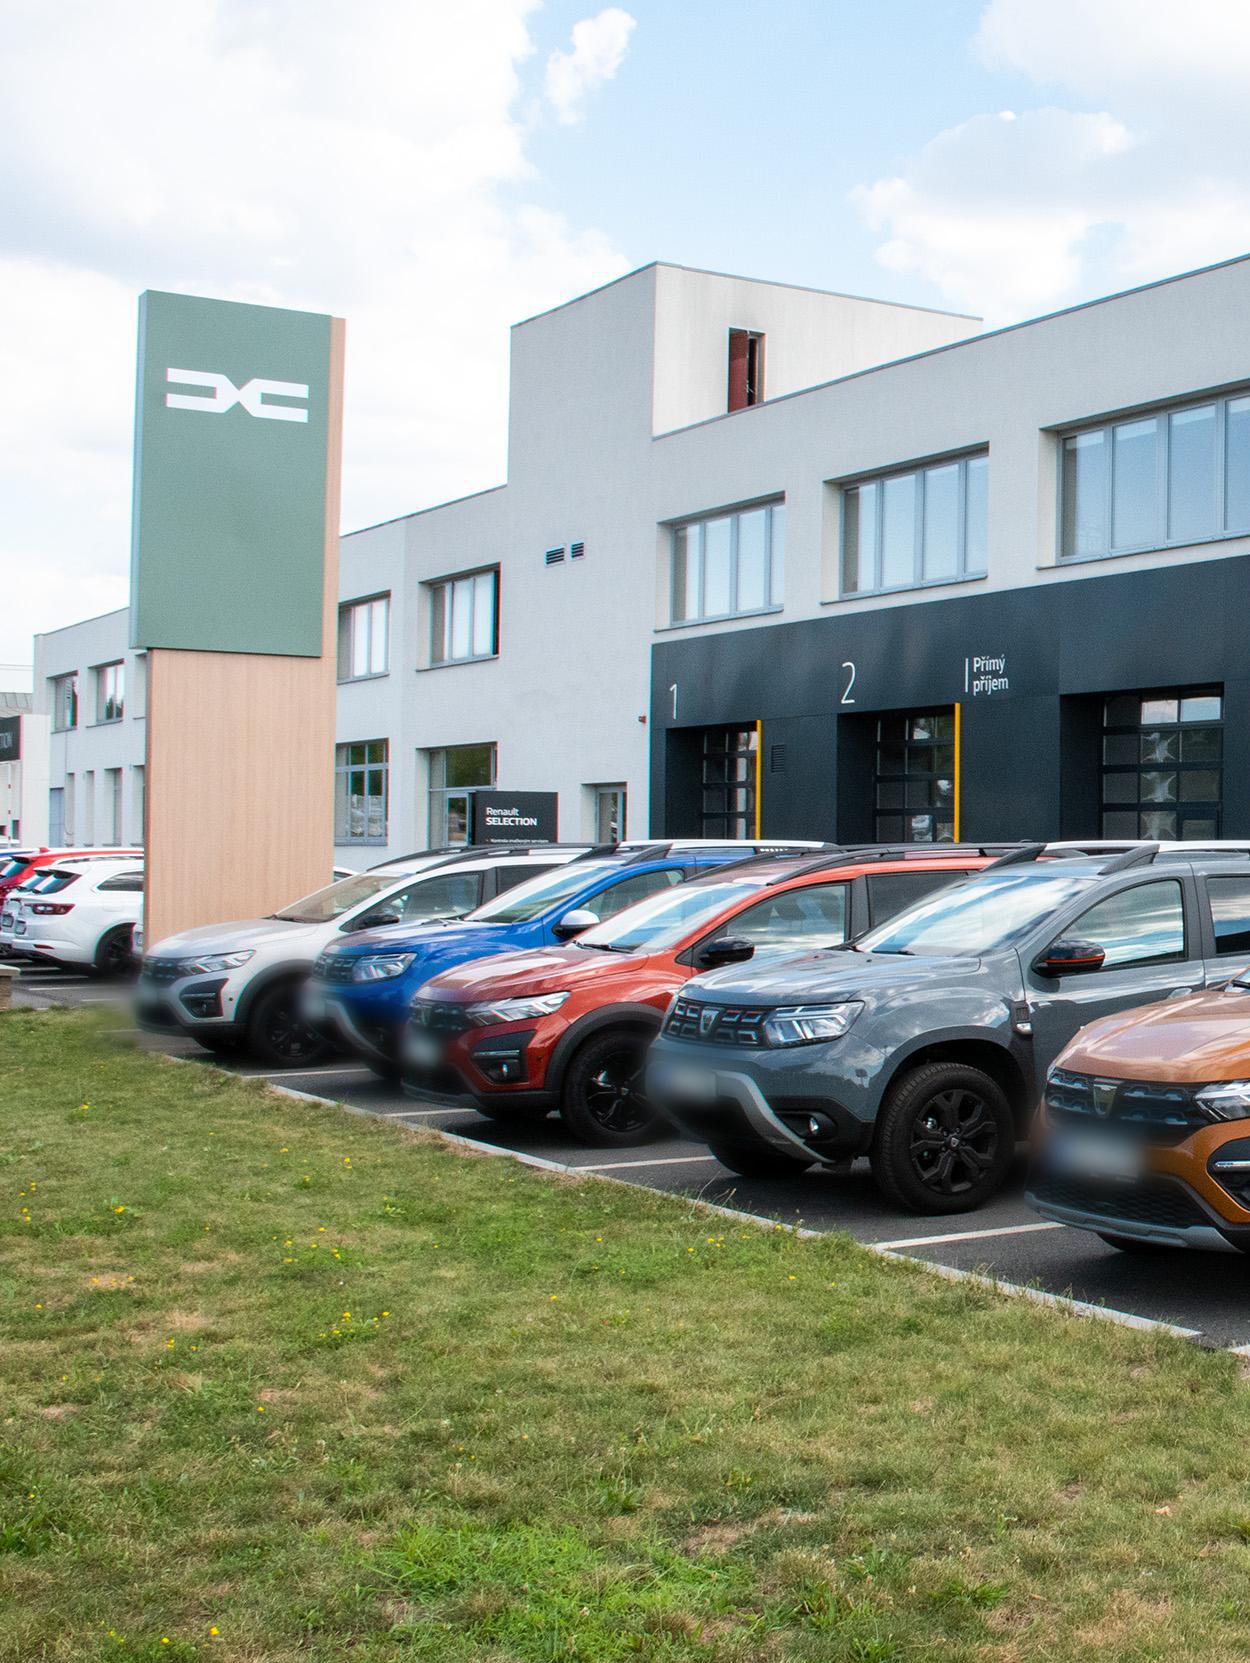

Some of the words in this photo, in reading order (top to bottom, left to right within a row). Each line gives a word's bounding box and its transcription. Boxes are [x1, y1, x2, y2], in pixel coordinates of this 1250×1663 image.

[973, 653, 1006, 674] Přímý
[840, 661, 856, 704] 2
[973, 675, 1009, 696] příjem
[669, 683, 678, 720] 1
[485, 817, 538, 826] SELECTION
[486, 807, 520, 816] Renault
